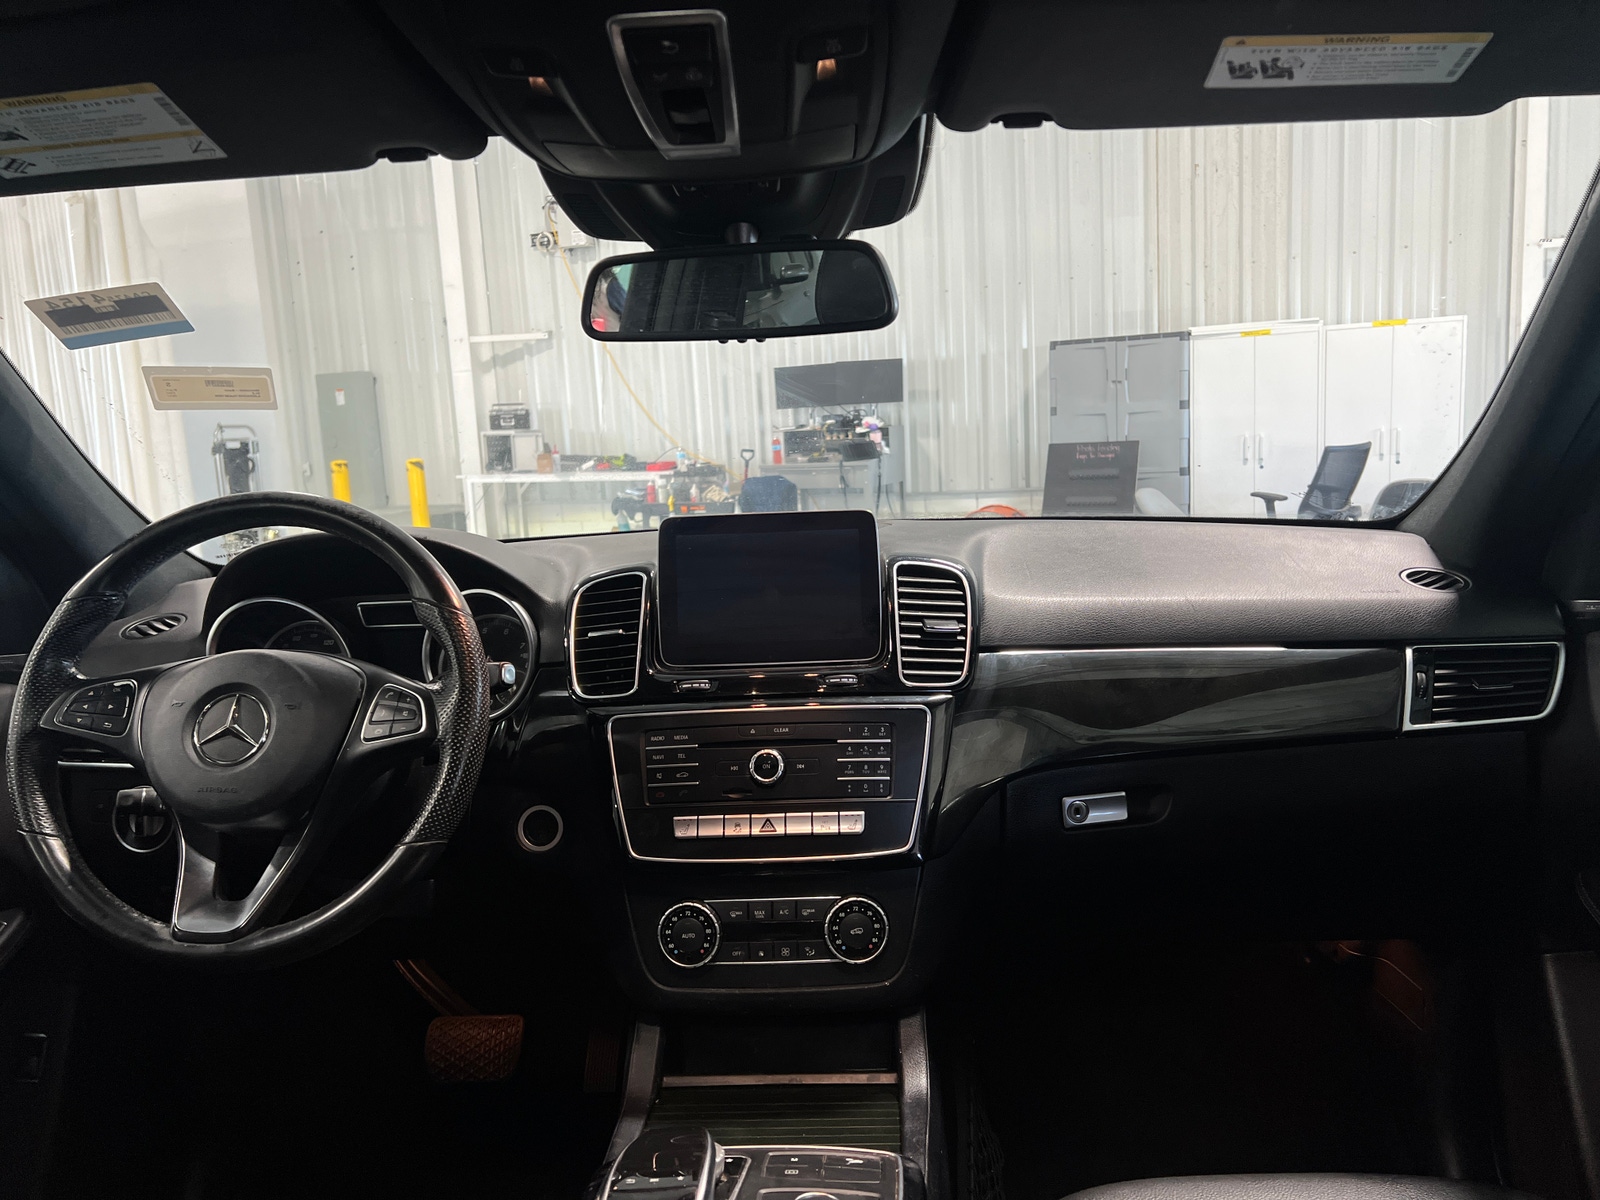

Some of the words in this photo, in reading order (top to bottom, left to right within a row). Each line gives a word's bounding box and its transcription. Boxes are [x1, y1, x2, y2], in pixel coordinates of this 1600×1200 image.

[1323, 35, 1391, 44] WARNING
[3, 95, 67, 107] WARNING
[197, 786, 238, 794] AIRBAG
